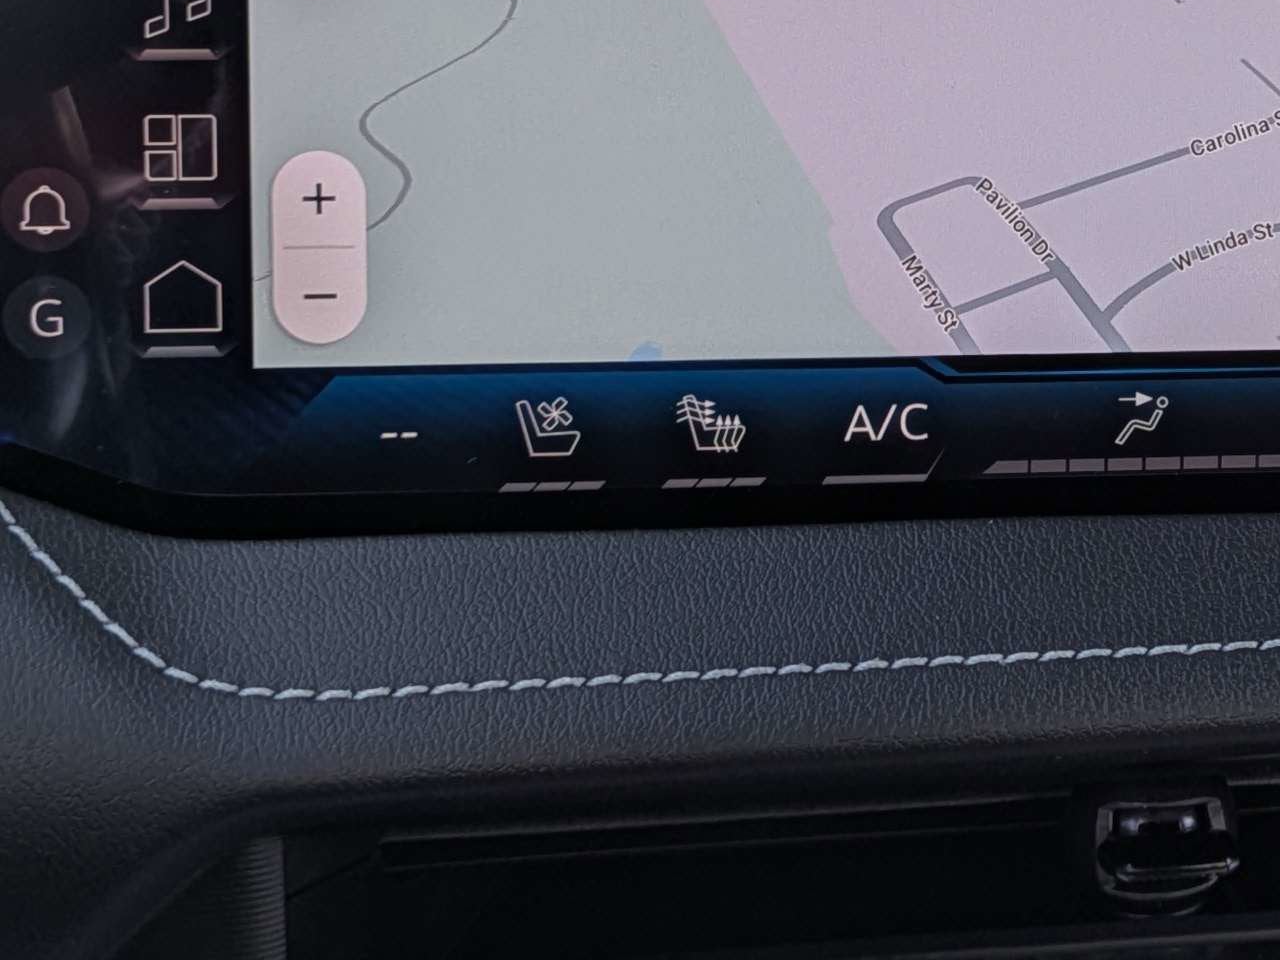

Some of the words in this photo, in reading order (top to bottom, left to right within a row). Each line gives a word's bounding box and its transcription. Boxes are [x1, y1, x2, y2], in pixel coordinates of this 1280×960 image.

[1191, 120, 1270, 156] Carolina
[975, 178, 1035, 243] Pavilion
[1031, 239, 1054, 263] Dr
[1172, 250, 1192, 271] W
[1196, 230, 1249, 261] Linda
[1252, 223, 1274, 240] St
[902, 254, 943, 309] Marty
[937, 309, 958, 333] St
[29, 298, 65, 338] G
[843, 402, 930, 443] A/C
